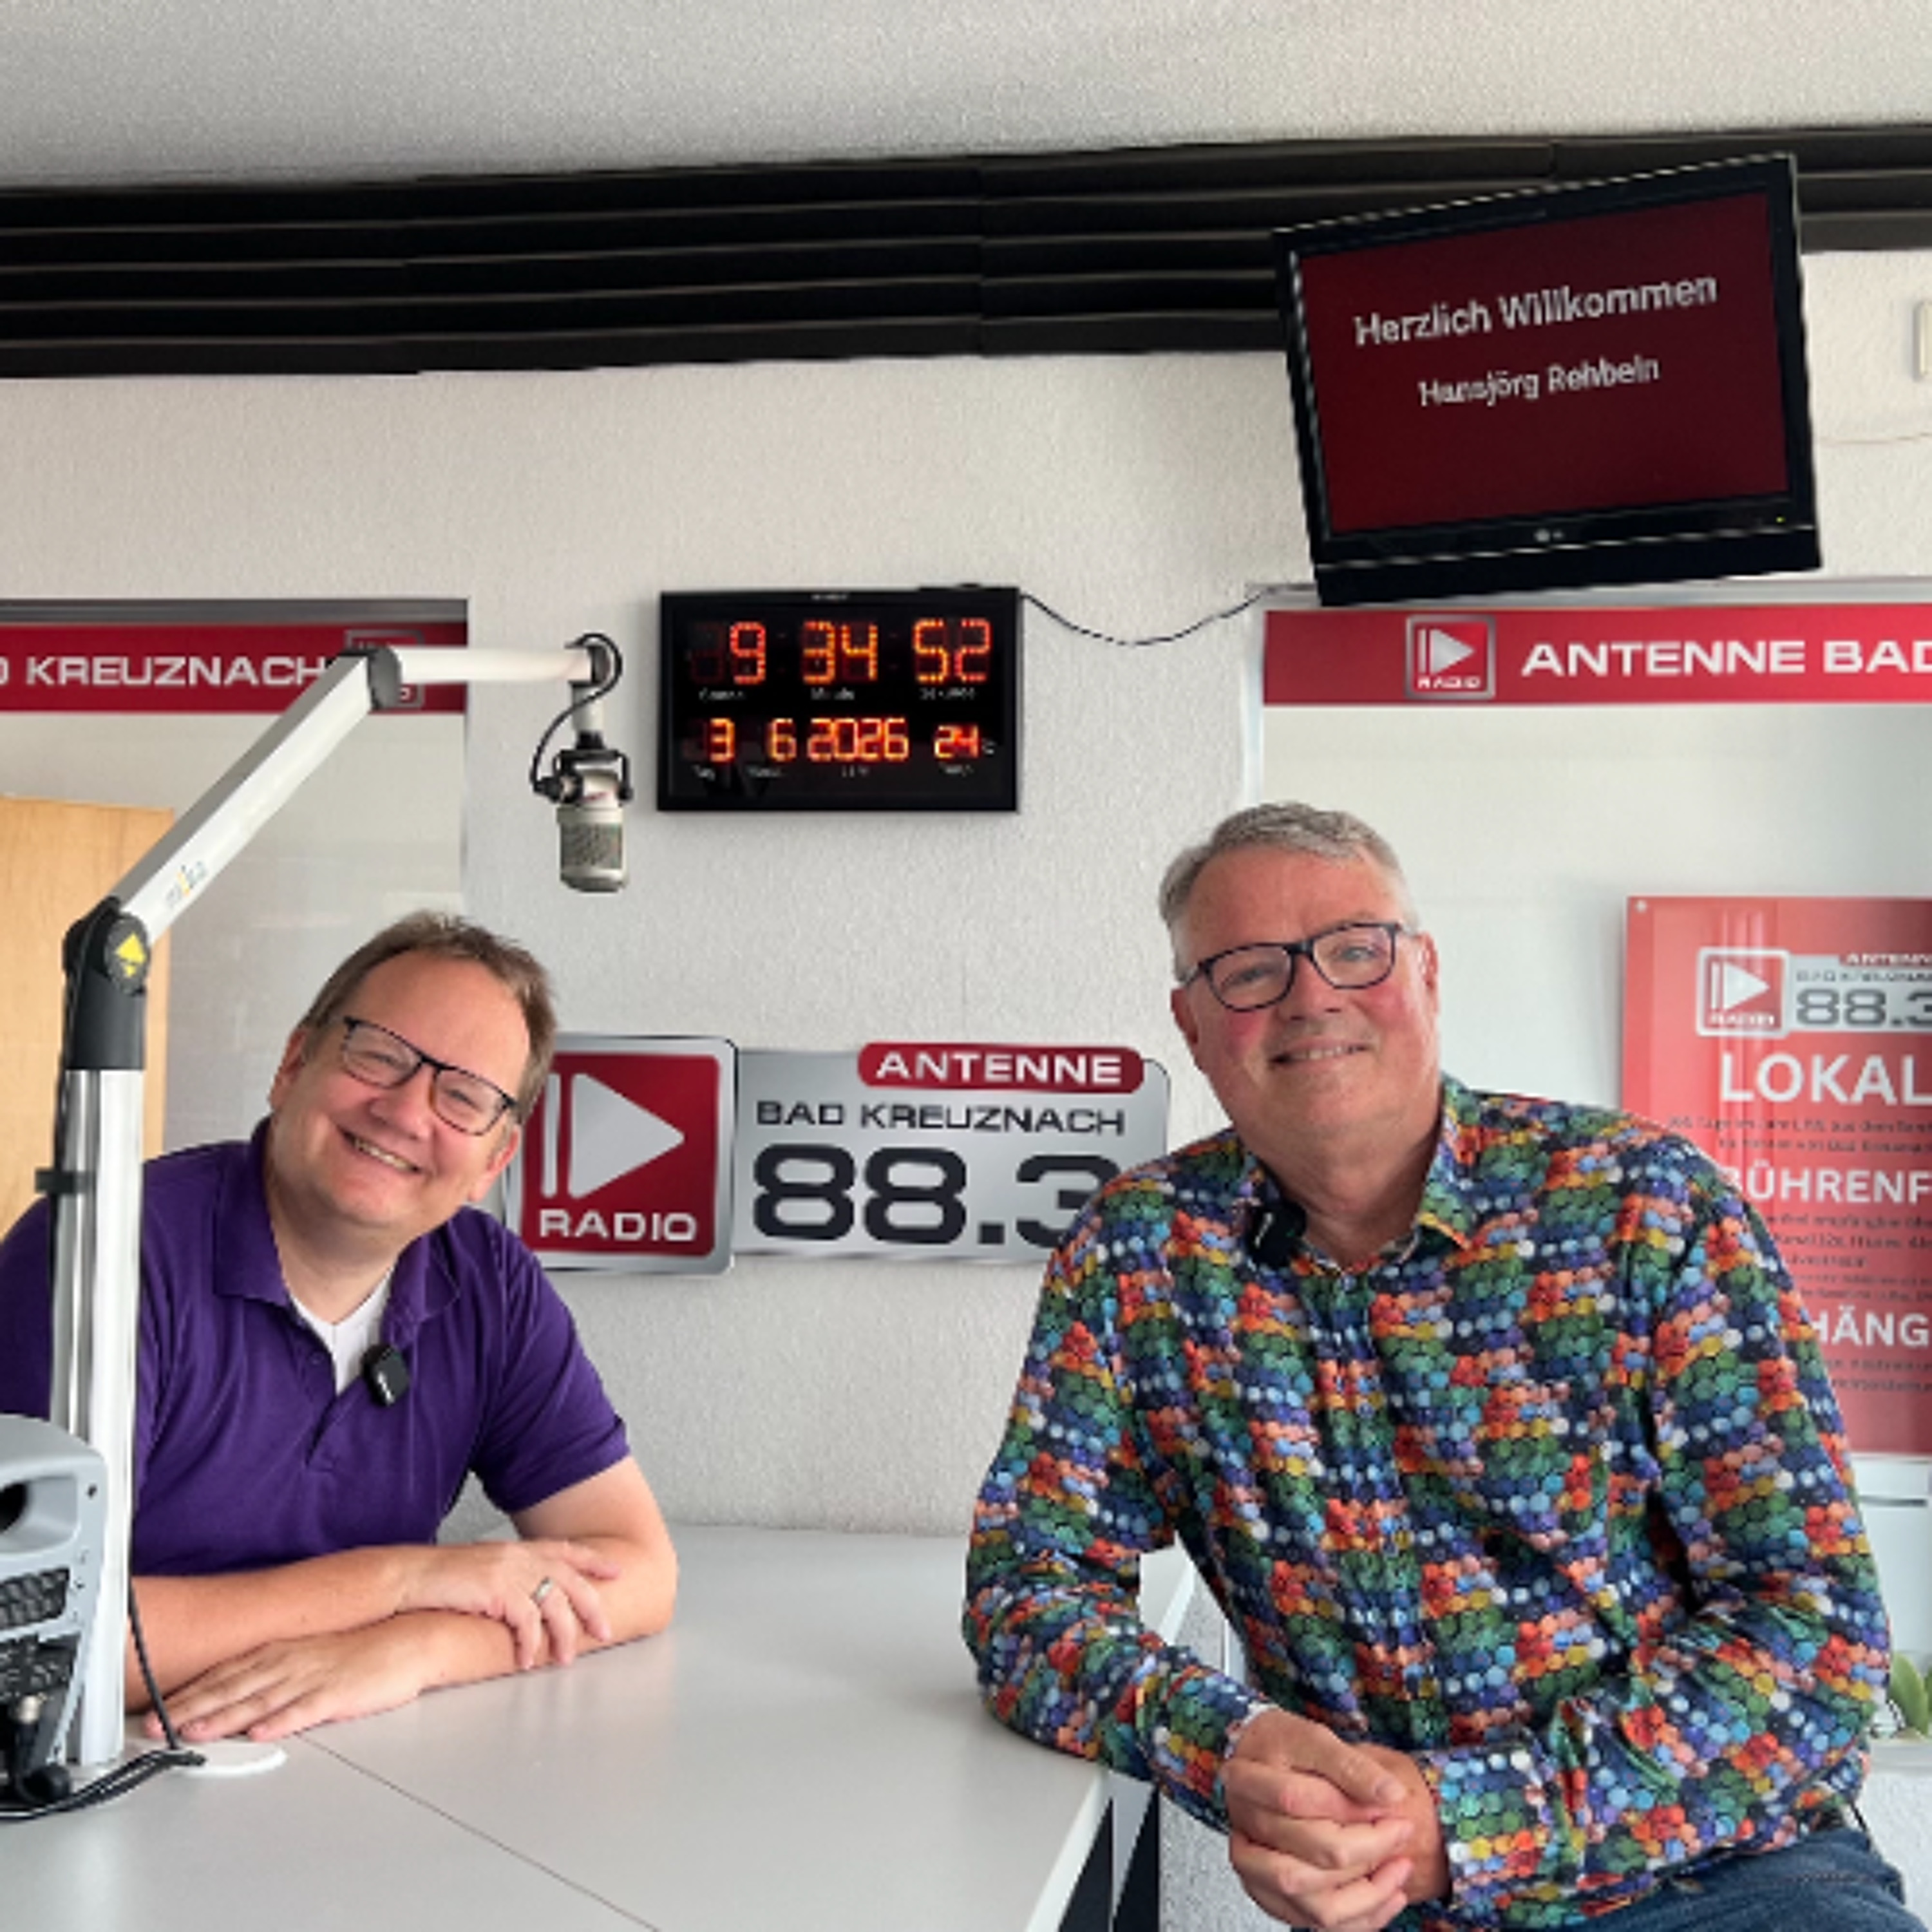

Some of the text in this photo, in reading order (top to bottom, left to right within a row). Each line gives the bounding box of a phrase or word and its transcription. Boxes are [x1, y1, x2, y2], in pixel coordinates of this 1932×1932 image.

[1354, 276, 1718, 346] Herzlich Willkommen
[26, 655, 325, 687] KREUZNACH
[729, 617, 991, 684] 9 34 52
[1520, 639, 1806, 677] ANTENNE
[710, 717, 979, 762] 3 6 2026 24
[876, 1050, 1122, 1085] ANTENNE
[1721, 1052, 1932, 1106] LOKAL
[756, 1100, 1124, 1136] BAD KREUZNACH
[753, 1143, 1122, 1249] 88.3
[540, 1208, 697, 1242] RADIO
